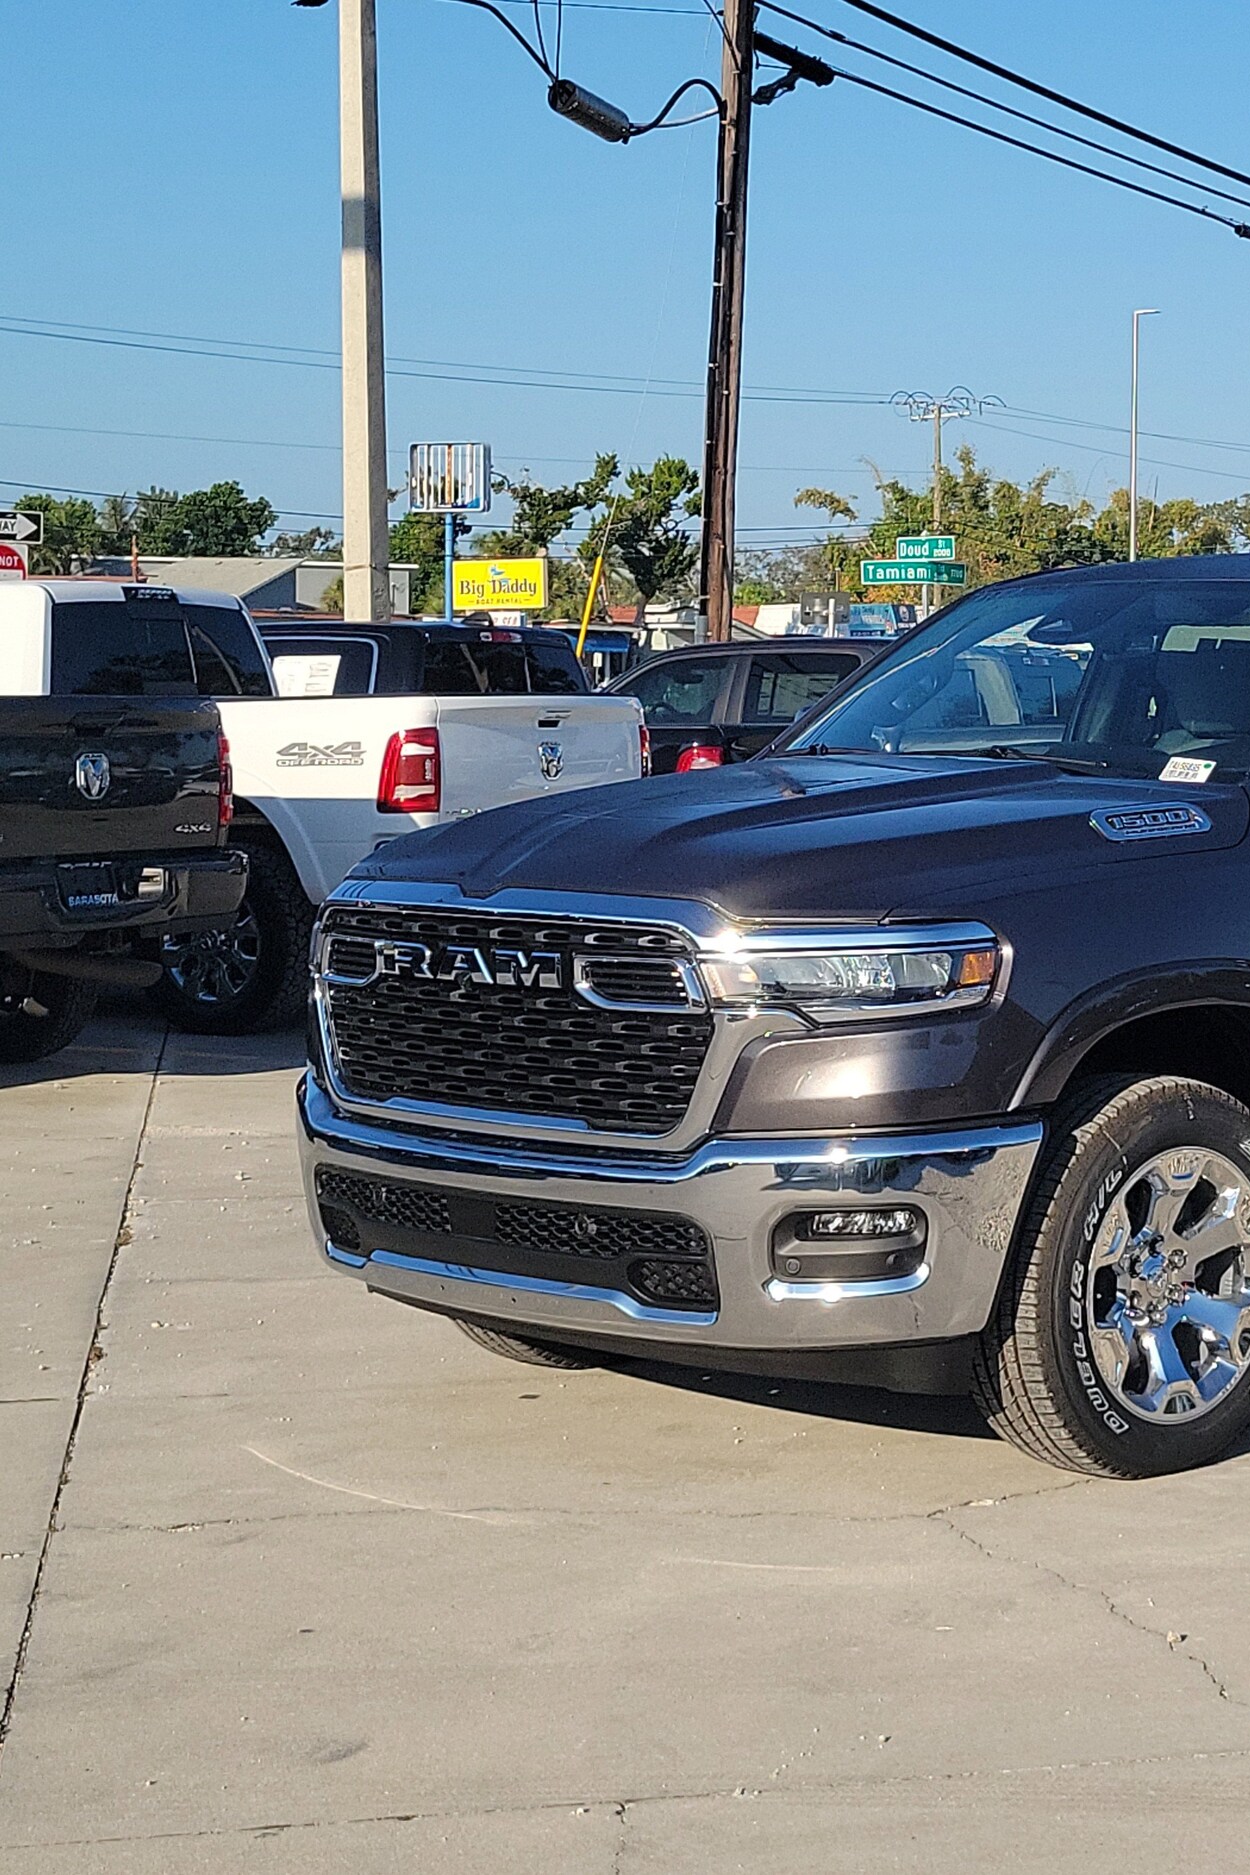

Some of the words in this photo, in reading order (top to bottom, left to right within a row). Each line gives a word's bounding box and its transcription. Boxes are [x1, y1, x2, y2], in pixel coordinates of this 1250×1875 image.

[900, 542, 929, 557] Doud
[867, 564, 931, 579] Tamiami
[460, 579, 485, 597] Big
[490, 578, 537, 597] Daddy
[1108, 810, 1189, 830] 1500
[68, 893, 119, 907] SARASOTA
[375, 940, 563, 989] RAM
[1071, 1260, 1130, 1435] DUELER
